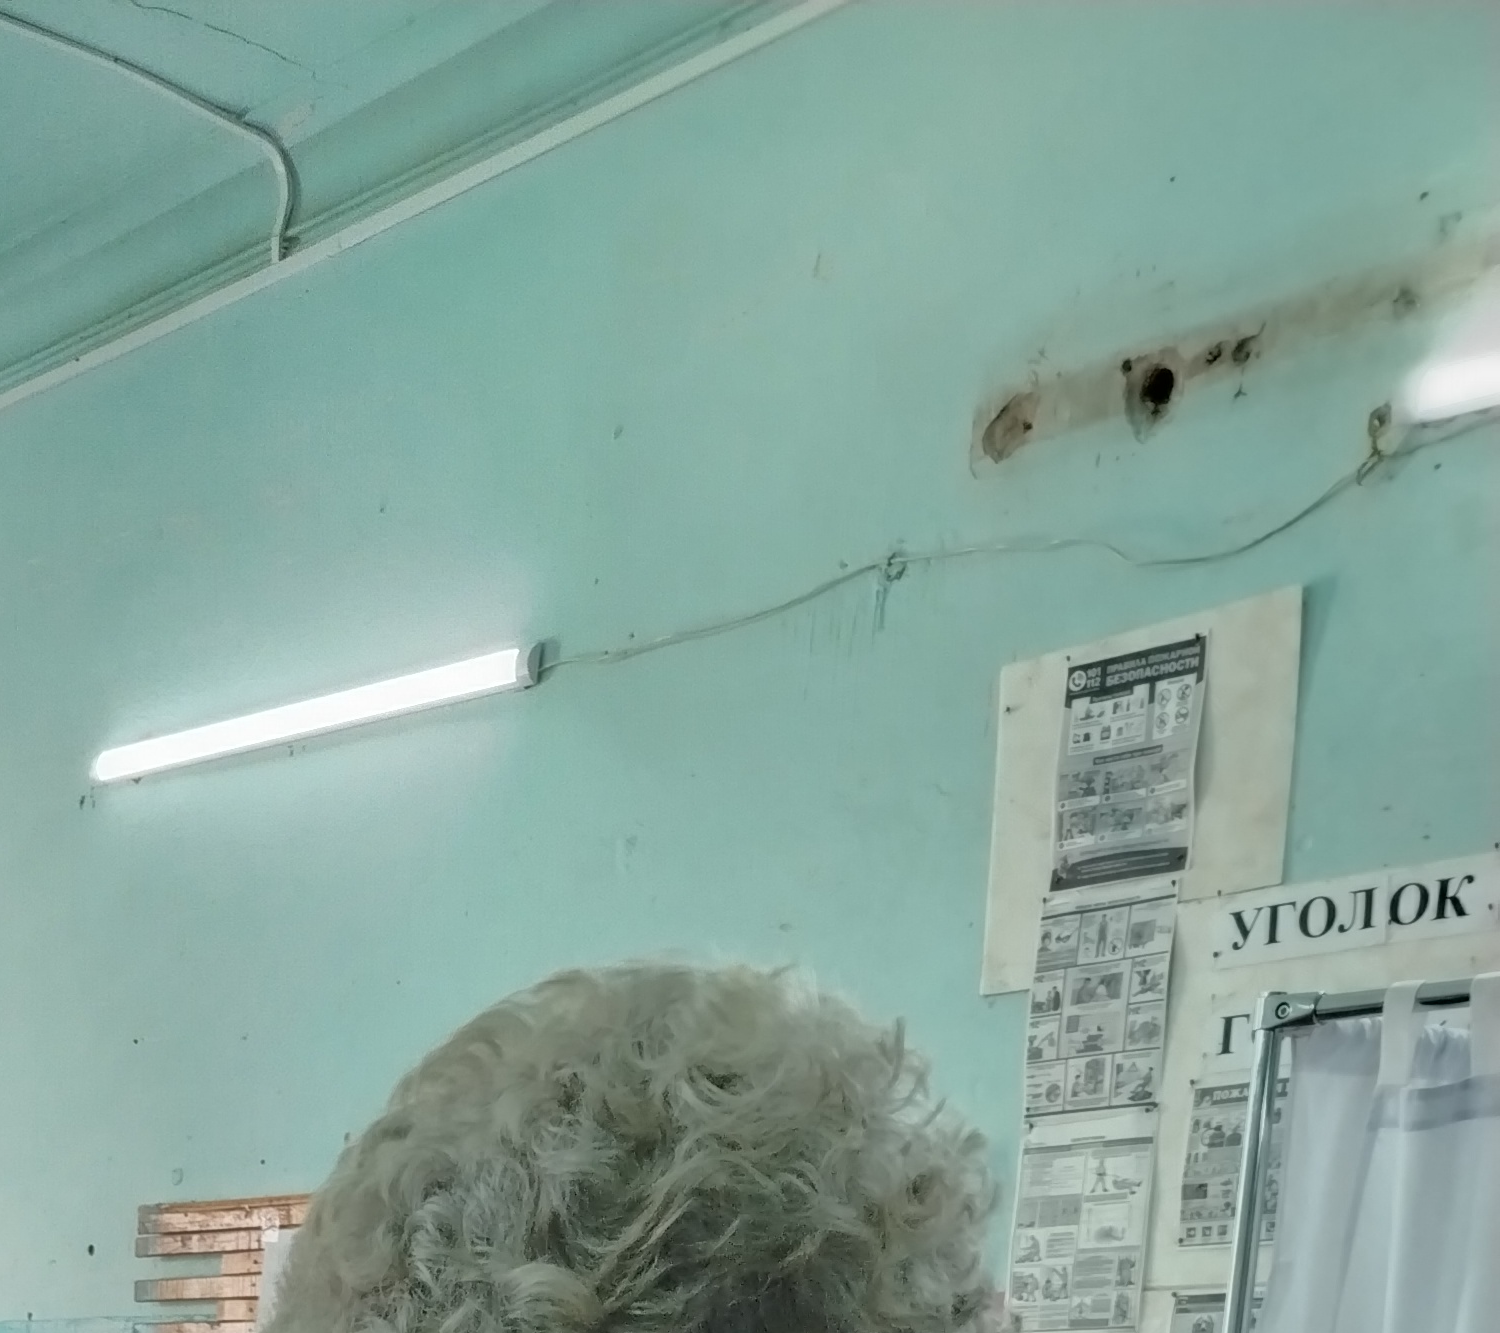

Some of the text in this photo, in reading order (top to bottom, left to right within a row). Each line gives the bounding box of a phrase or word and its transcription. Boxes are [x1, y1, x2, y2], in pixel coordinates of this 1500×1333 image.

[1105, 656, 1200, 687] БЕЗОПАСНОСТИ
[1106, 657, 1147, 675] ПРАВИЛА
[1228, 874, 1475, 951] УГОЛОК
[1212, 1087, 1250, 1101] ПОЖА
